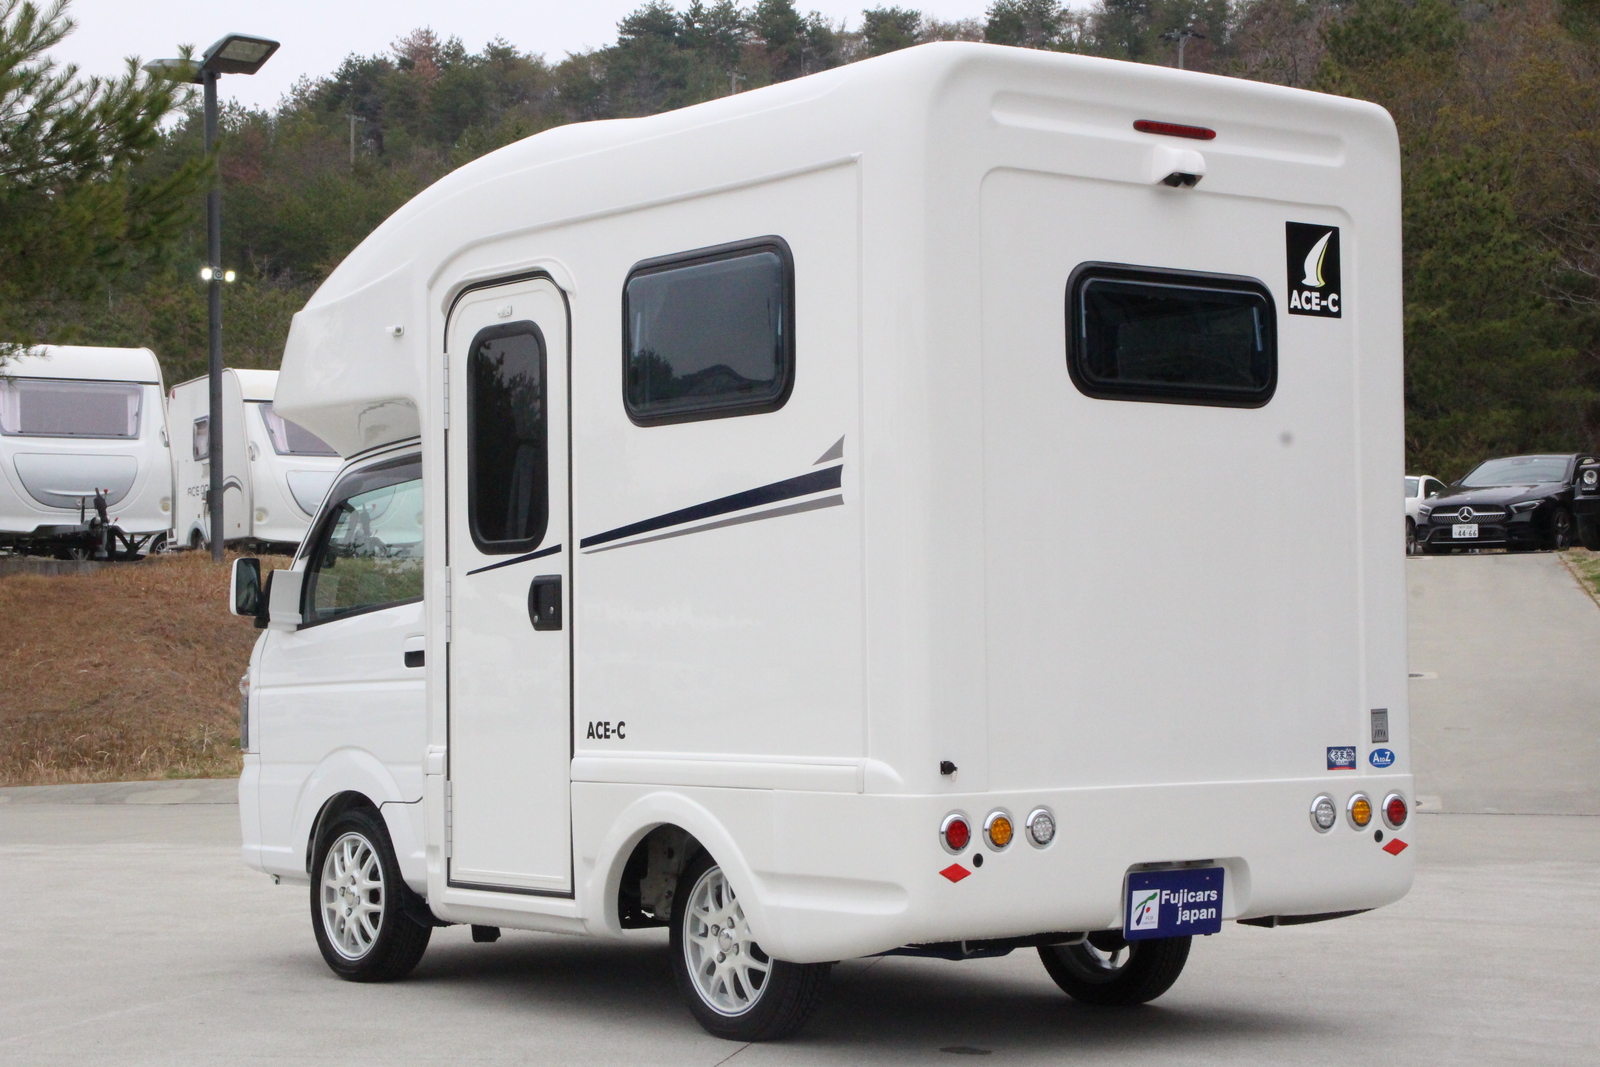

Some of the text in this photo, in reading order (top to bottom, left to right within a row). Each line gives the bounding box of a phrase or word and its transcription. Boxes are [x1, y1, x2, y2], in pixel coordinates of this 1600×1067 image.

[1289, 289, 1339, 313] ACE-C
[586, 720, 626, 740] ACE-C
[1161, 888, 1218, 907] Fujicars
[1176, 907, 1216, 925] japan
